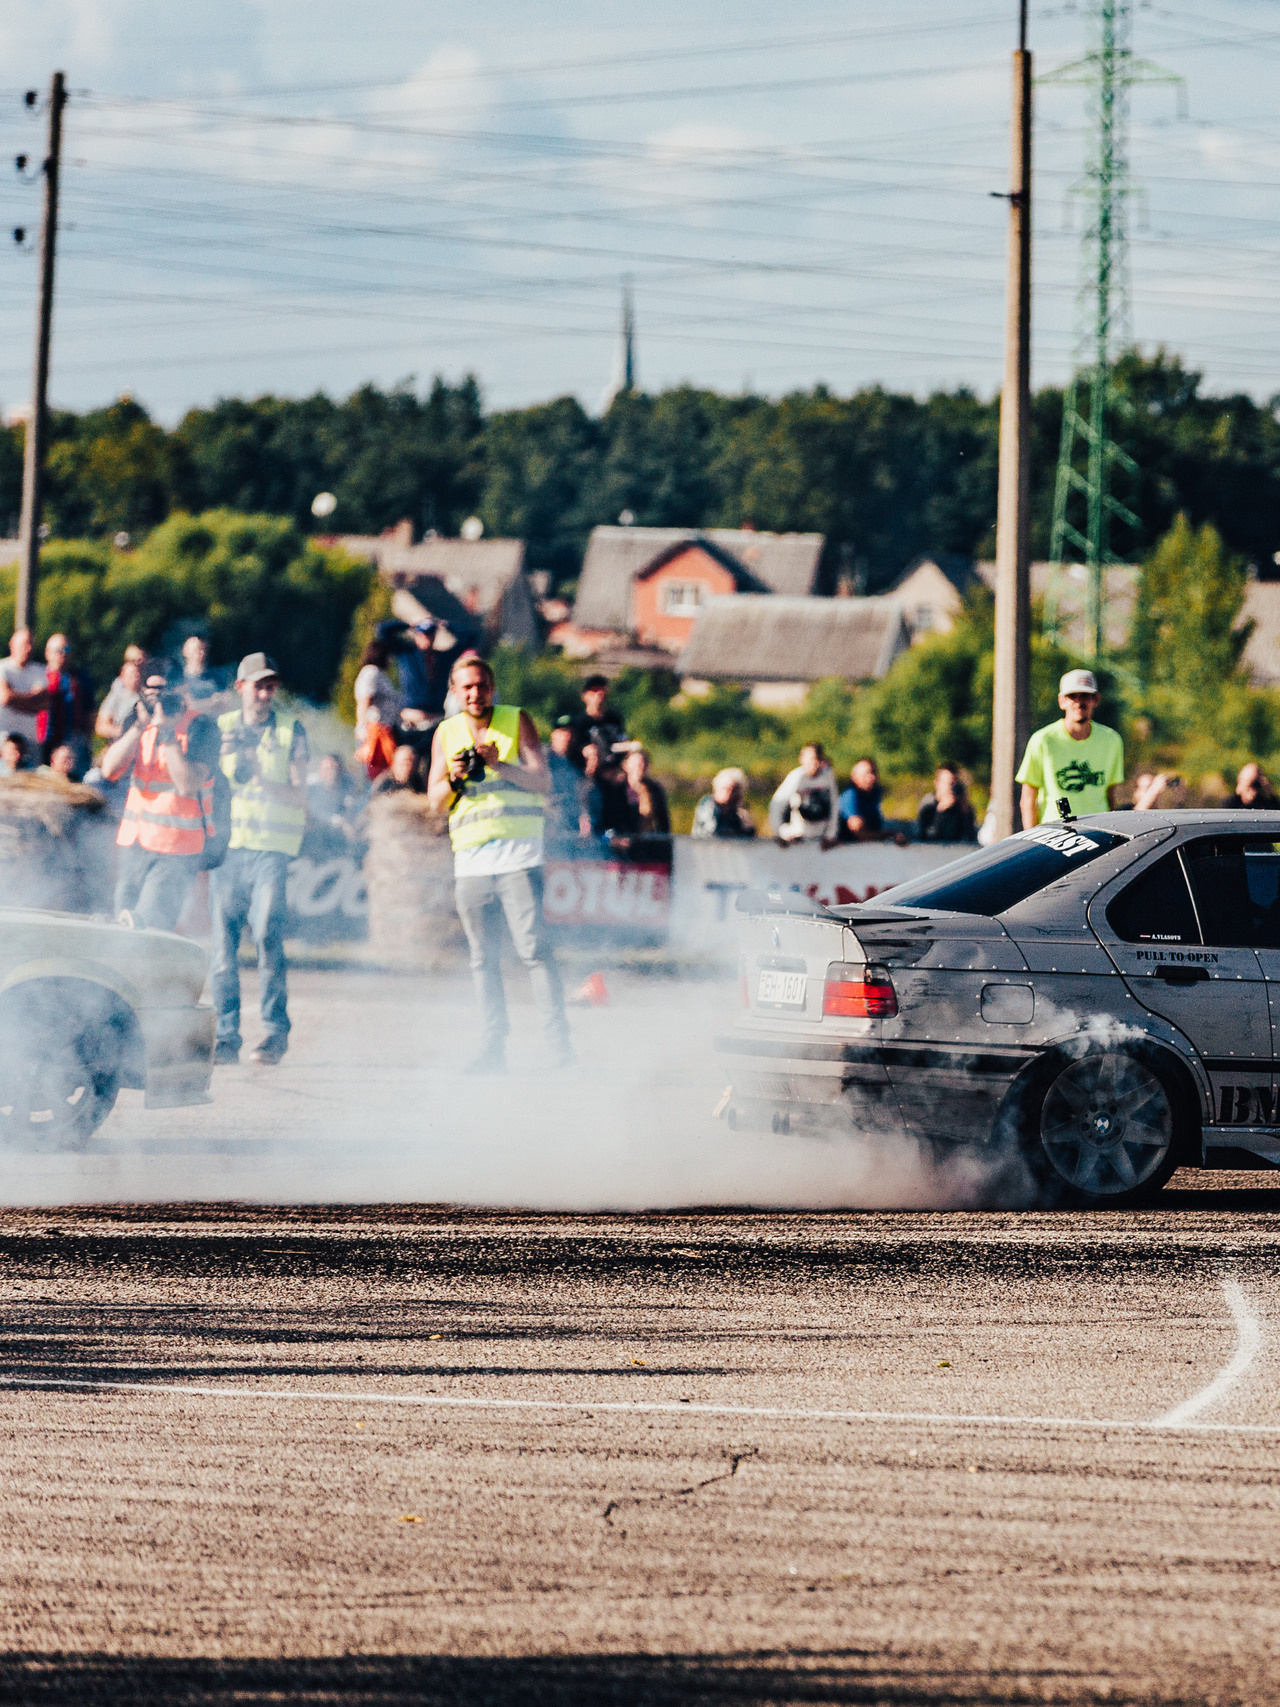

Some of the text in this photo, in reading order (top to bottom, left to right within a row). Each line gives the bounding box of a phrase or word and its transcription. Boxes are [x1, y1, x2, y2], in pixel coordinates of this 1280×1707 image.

[545, 868, 662, 917] OTUL
[1136, 950, 1219, 963] PULL TO OPEN
